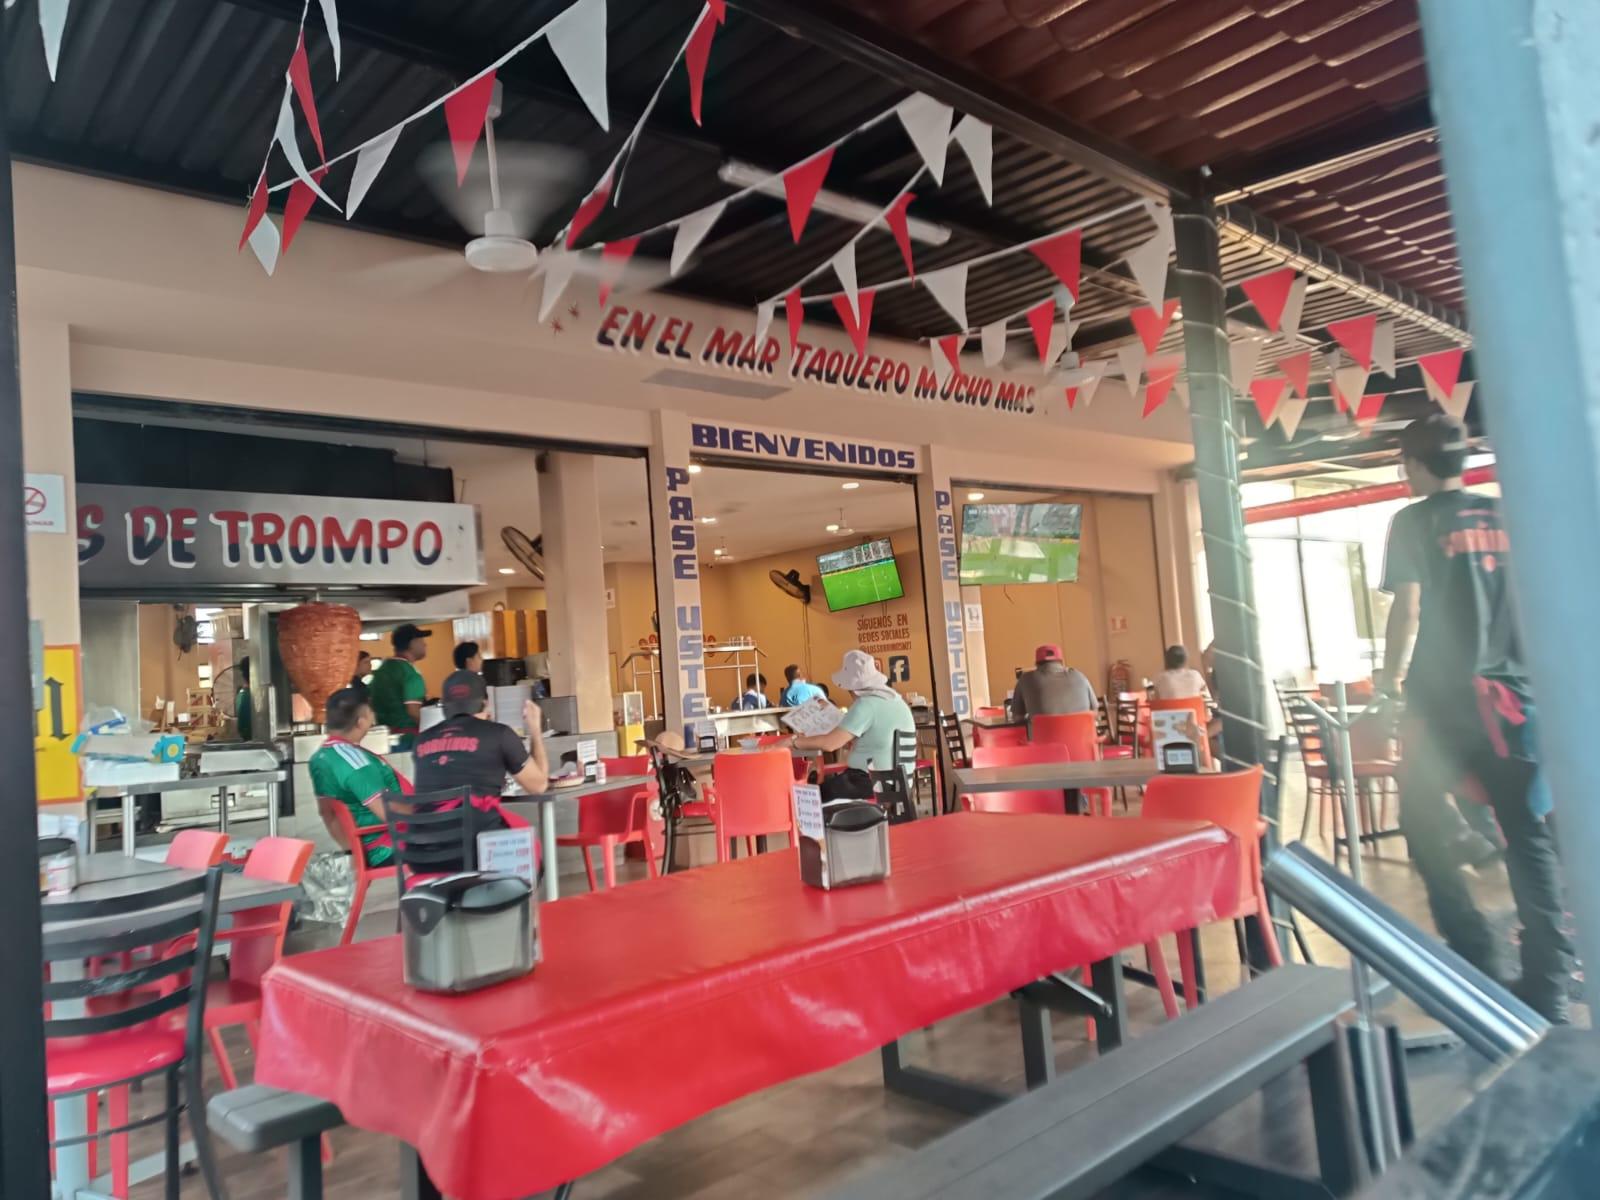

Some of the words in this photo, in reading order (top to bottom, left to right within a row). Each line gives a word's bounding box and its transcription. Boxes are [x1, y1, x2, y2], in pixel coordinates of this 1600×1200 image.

[597, 305, 656, 353] EN
[655, 317, 694, 361] EL
[701, 326, 780, 374] MAR
[790, 342, 910, 396] TAQUERO
[914, 366, 992, 407] MUCHO
[993, 381, 1036, 414] MAS
[692, 423, 915, 469] BIENVENIDOS
[125, 505, 198, 569] DE
[208, 510, 443, 569] TROMPO
[666, 467, 698, 580] PASE
[936, 491, 957, 580] PASE
[881, 627, 911, 641] SOCIALES
[897, 613, 909, 627] EN
[945, 601, 969, 715] USTED
